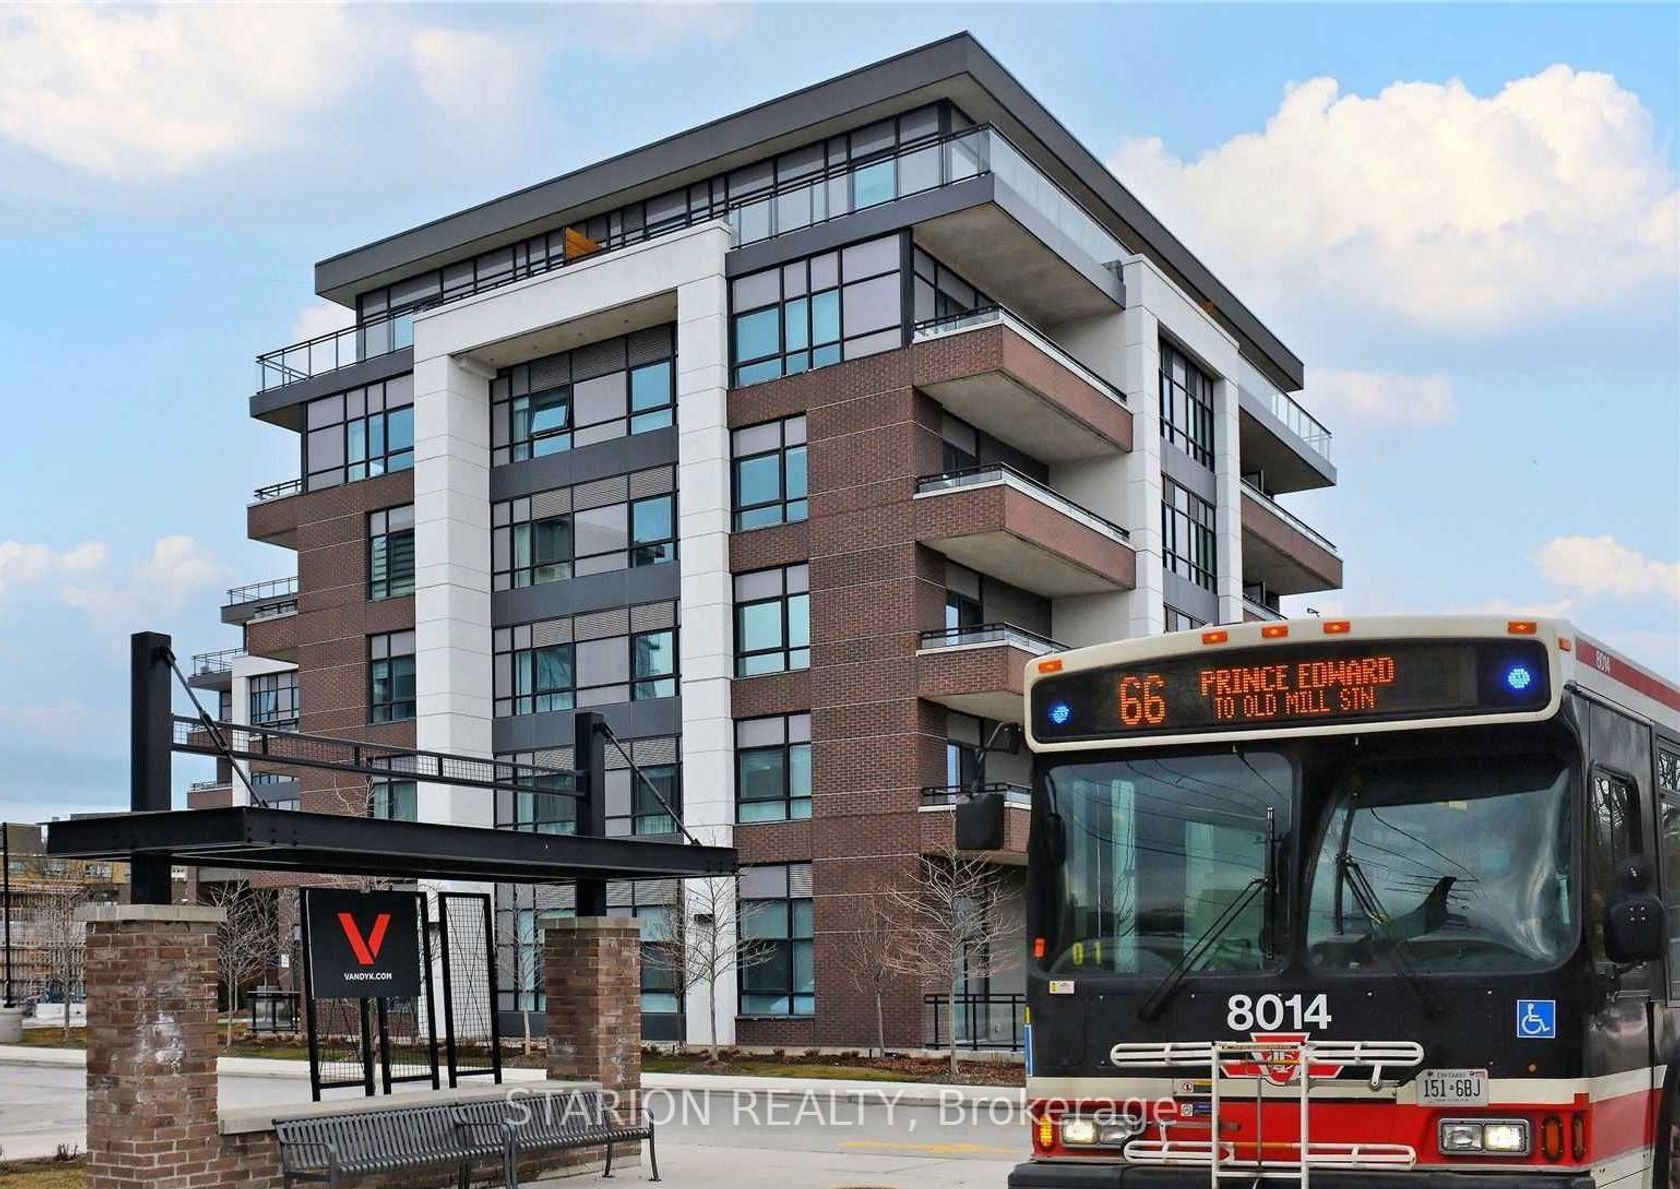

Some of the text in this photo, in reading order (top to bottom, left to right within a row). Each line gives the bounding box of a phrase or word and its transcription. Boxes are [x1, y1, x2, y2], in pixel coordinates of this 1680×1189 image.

[1201, 657, 1394, 696] PRINCE EDWARD
[1120, 675, 1166, 726] 66
[1215, 687, 1375, 719] TO OLD MILL STN
[338, 912, 391, 964] V
[344, 972, 393, 981] VANDYK.COM
[1227, 993, 1332, 1031] 8014
